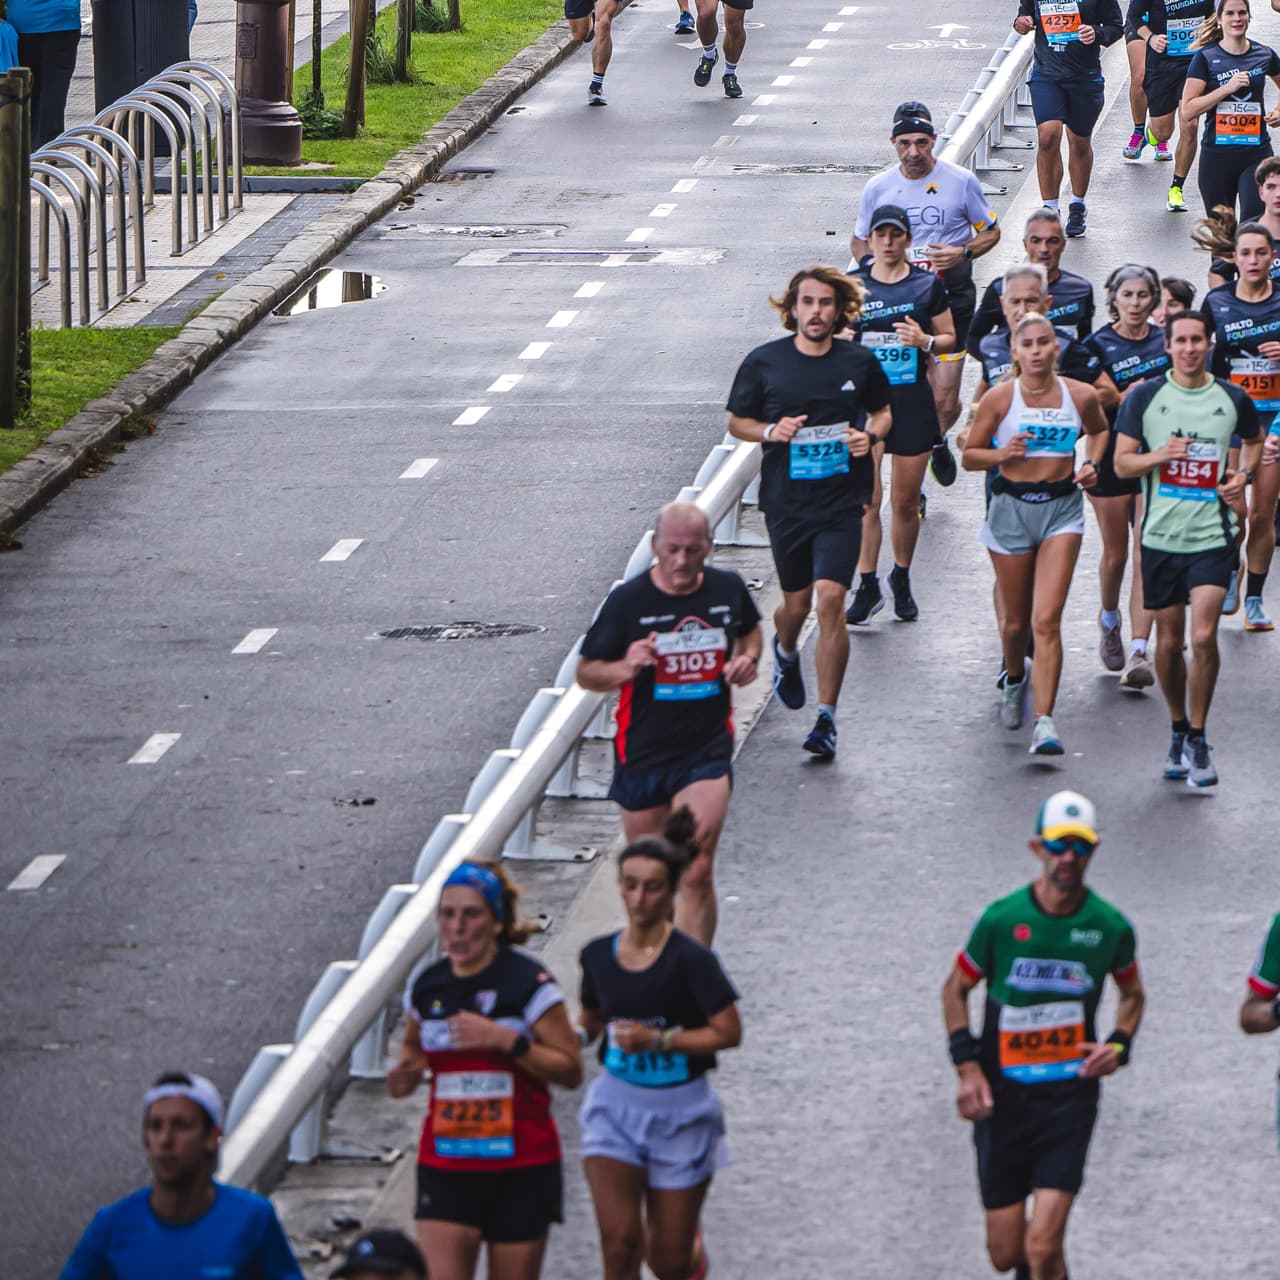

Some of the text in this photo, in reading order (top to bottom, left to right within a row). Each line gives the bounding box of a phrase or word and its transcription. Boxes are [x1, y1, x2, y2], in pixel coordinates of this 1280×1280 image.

[1044, 15, 1076, 26] 4257
[1216, 68, 1240, 82] SALTO
[1218, 115, 1257, 127] 4004
[1224, 319, 1253, 333] SALTO
[875, 348, 912, 363] 396
[1112, 355, 1141, 372] SALTO
[1115, 355, 1169, 382] FOUNDATION
[1240, 376, 1275, 390] 4151
[799, 440, 845, 458] 5328
[1167, 459, 1213, 479] 3154
[665, 651, 718, 674] 3103
[1007, 1026, 1078, 1052] 4042
[440, 1099, 503, 1122] 4225
